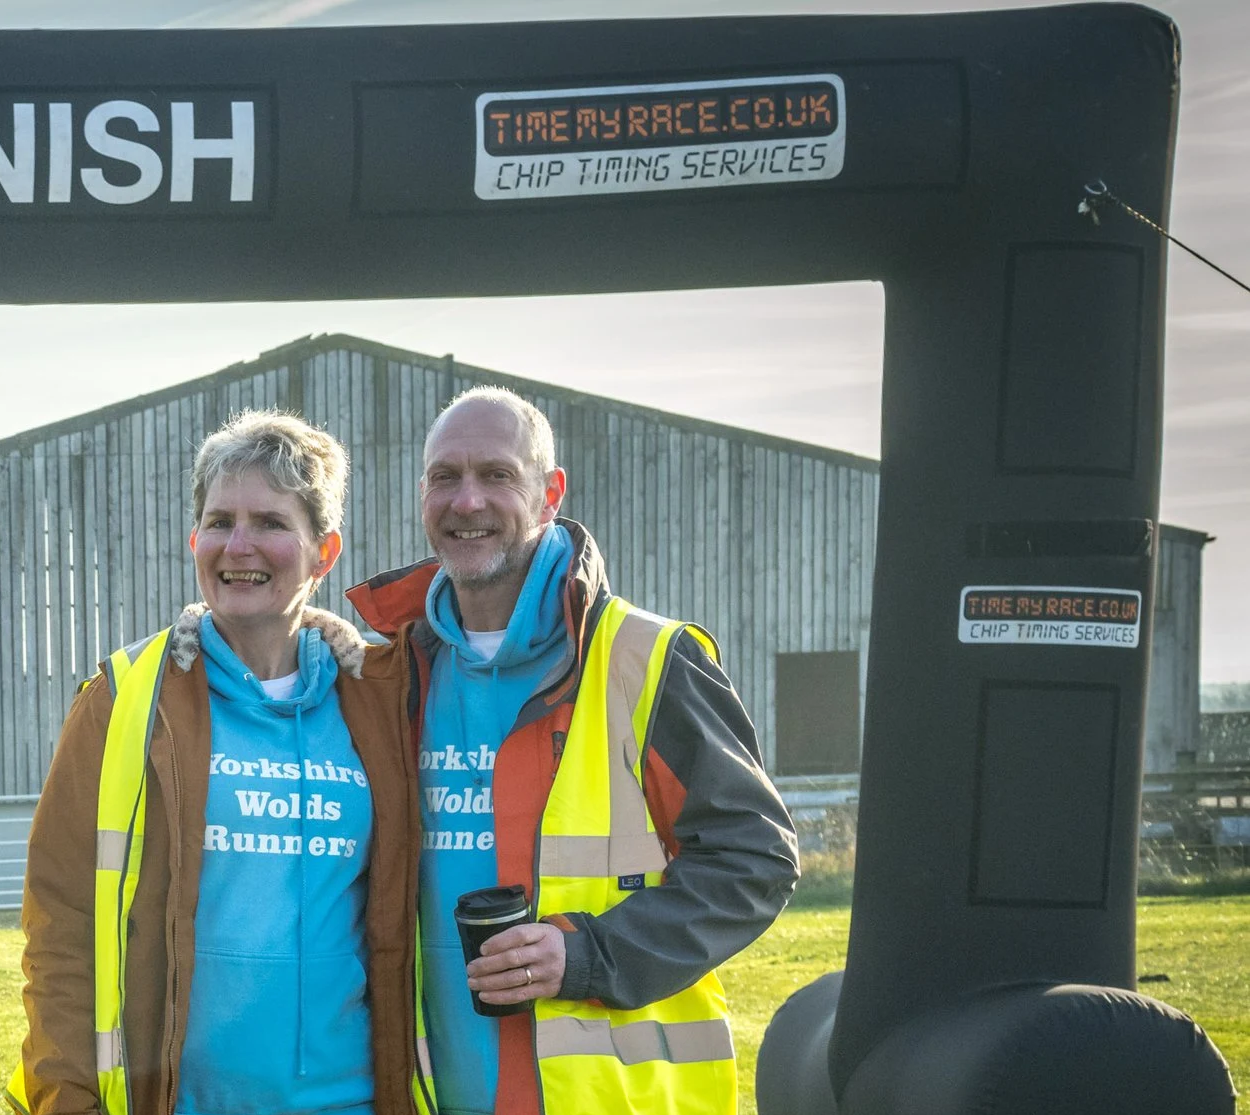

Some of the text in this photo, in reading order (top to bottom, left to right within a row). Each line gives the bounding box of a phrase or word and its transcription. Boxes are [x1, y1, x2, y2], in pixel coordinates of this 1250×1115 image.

[496, 142, 829, 191] CHIP TIMING SERVICES
[970, 623, 1135, 643] CHIP TIMING SERVICES
[209, 752, 368, 788] Yorkshire
[418, 744, 496, 771] orksh
[235, 789, 342, 822] Wolds
[424, 786, 494, 814] Wold
[203, 824, 358, 858] Runners
[422, 830, 495, 851] unne
[621, 877, 642, 887] LEO
